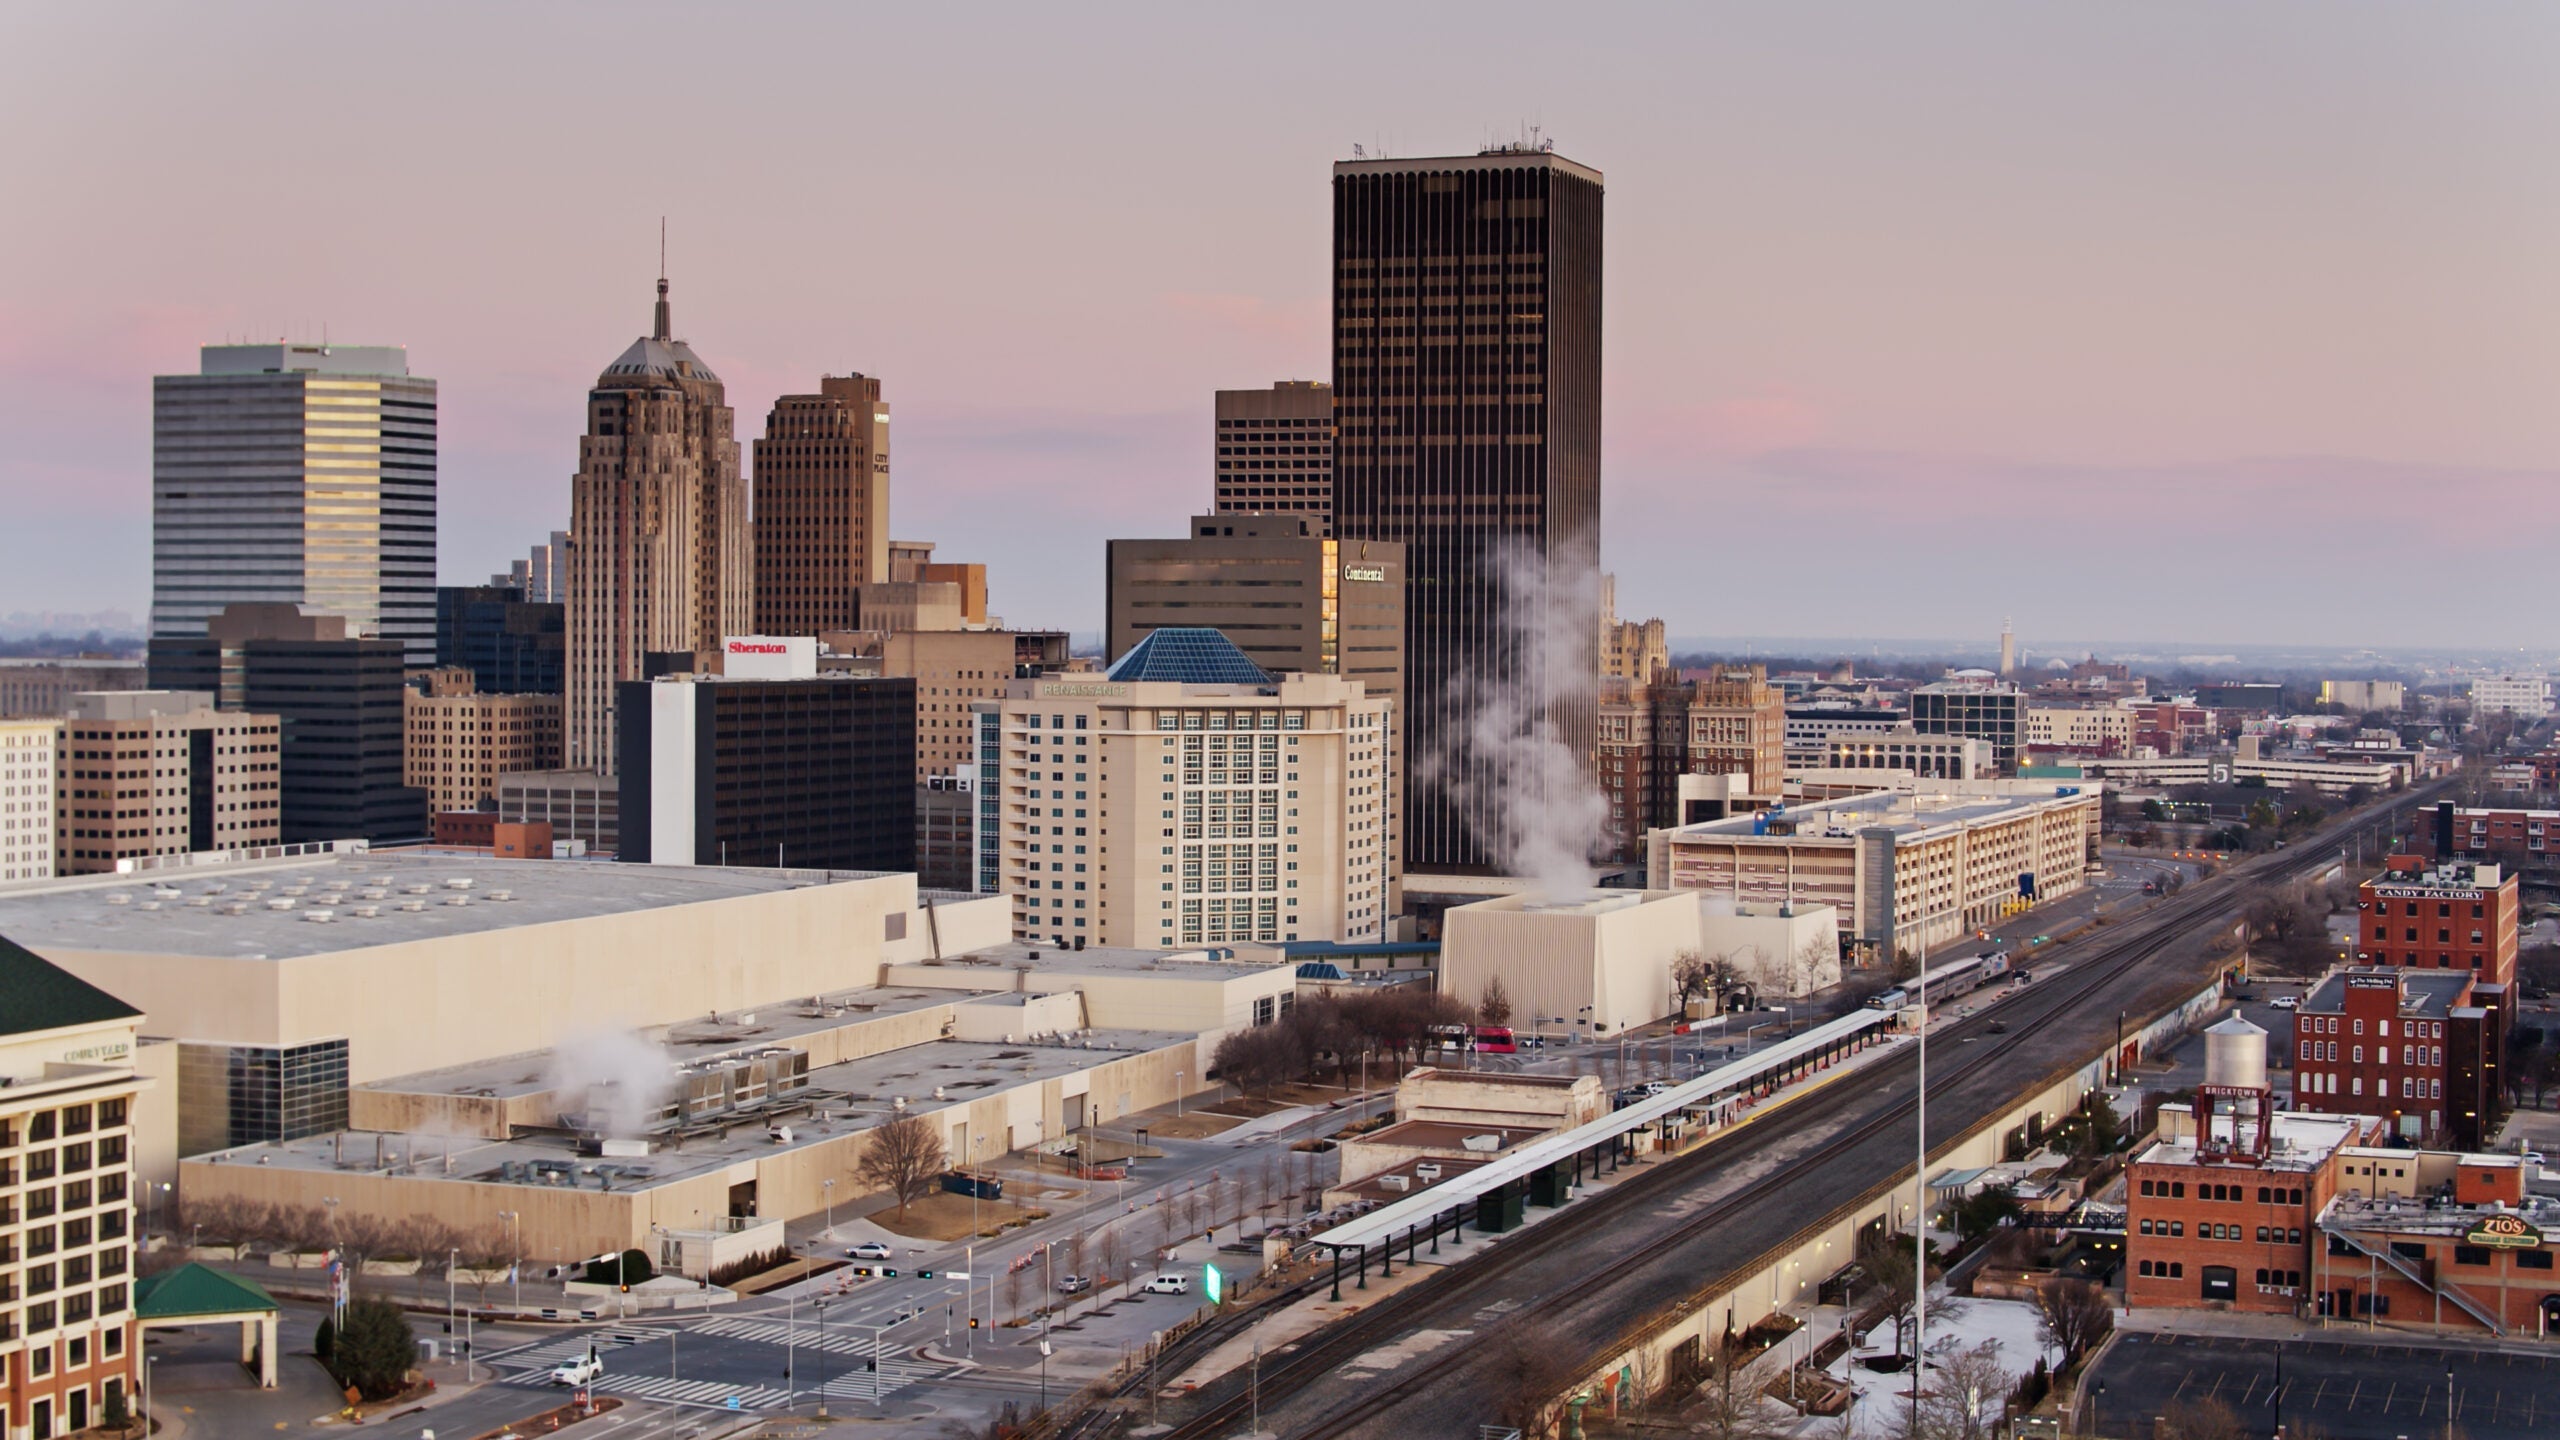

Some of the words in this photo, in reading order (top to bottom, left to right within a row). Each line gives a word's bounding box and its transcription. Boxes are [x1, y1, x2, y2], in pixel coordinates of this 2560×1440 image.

[875, 454, 887, 463] CITY
[873, 464, 889, 473] PLACE
[1344, 564, 1384, 581] Continental
[728, 642, 786, 653] Sheraton
[1043, 684, 1127, 697] RENAISSANCE
[2213, 763, 2228, 783] 5
[2376, 888, 2418, 897] CANDY
[2424, 889, 2481, 899] FACTORY
[64, 1043, 129, 1063] COURTYARD
[2205, 1086, 2258, 1097] BRICKTOWN
[2483, 1218, 2525, 1235] ZIO'S
